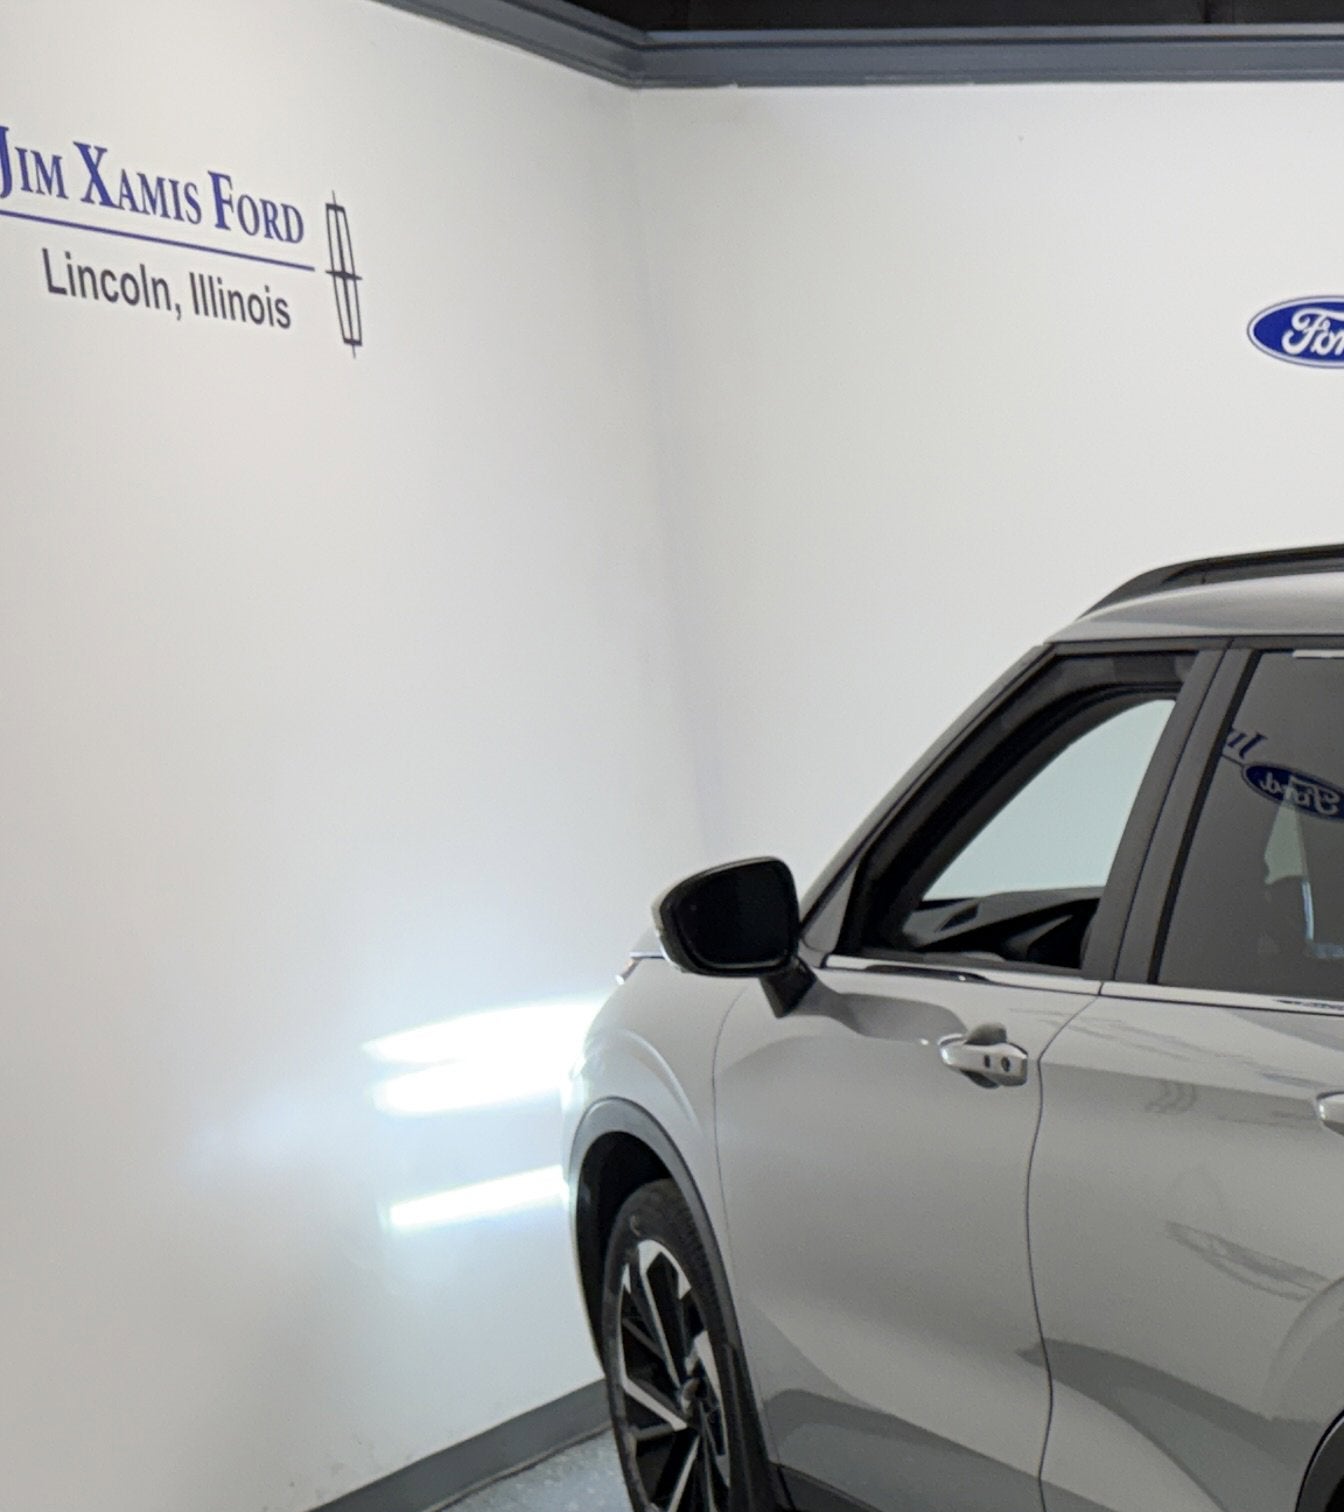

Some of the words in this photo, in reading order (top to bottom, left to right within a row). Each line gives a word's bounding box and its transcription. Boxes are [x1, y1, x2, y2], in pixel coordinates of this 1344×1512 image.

[72, 141, 202, 225] XAMIS
[207, 170, 305, 244] FORD
[42, 248, 182, 320] Lincoln,
[189, 272, 291, 329] Illinois
